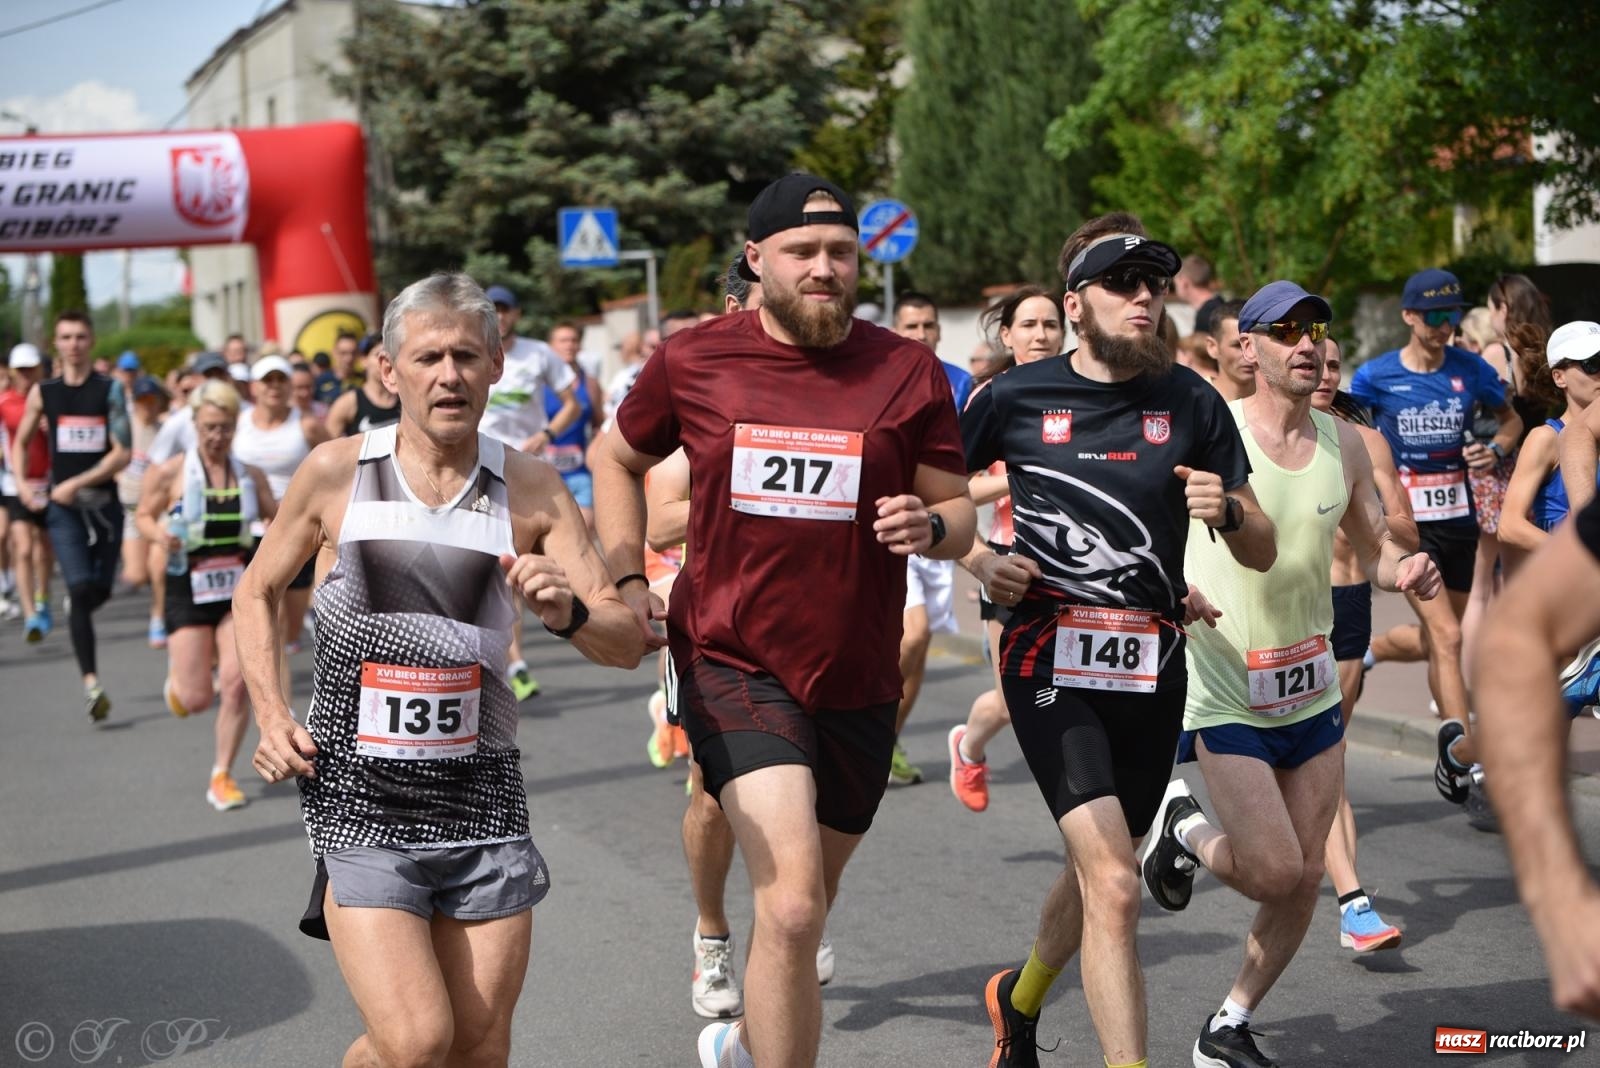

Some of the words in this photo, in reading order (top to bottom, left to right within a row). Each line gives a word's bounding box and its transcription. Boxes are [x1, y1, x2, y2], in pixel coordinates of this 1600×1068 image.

[12, 180, 136, 207] GRANIC
[1400, 416, 1463, 433] SILESIAN
[751, 428, 769, 438] XVI
[769, 430, 792, 439] BIEG
[792, 431, 809, 441] BEZ
[810, 433, 848, 444] GRANIC
[762, 456, 833, 495] 217
[1424, 486, 1457, 507] 199
[206, 570, 235, 588] 197
[1072, 609, 1088, 618] XVI
[1089, 611, 1109, 620] BIEG
[1109, 613, 1124, 621] BEZ
[1124, 614, 1150, 623] GRANIC
[1079, 633, 1141, 670] 148
[1258, 652, 1273, 660] XVI
[1273, 650, 1290, 658] BIEG
[1290, 647, 1300, 655] BEZ
[1300, 639, 1318, 651] GRANIC
[376, 667, 394, 677] XVI
[395, 669, 417, 680] BIEG
[418, 671, 436, 681] BEZ
[438, 670, 473, 681] GRANIC
[1275, 662, 1315, 698] 121
[386, 696, 461, 735] 135
